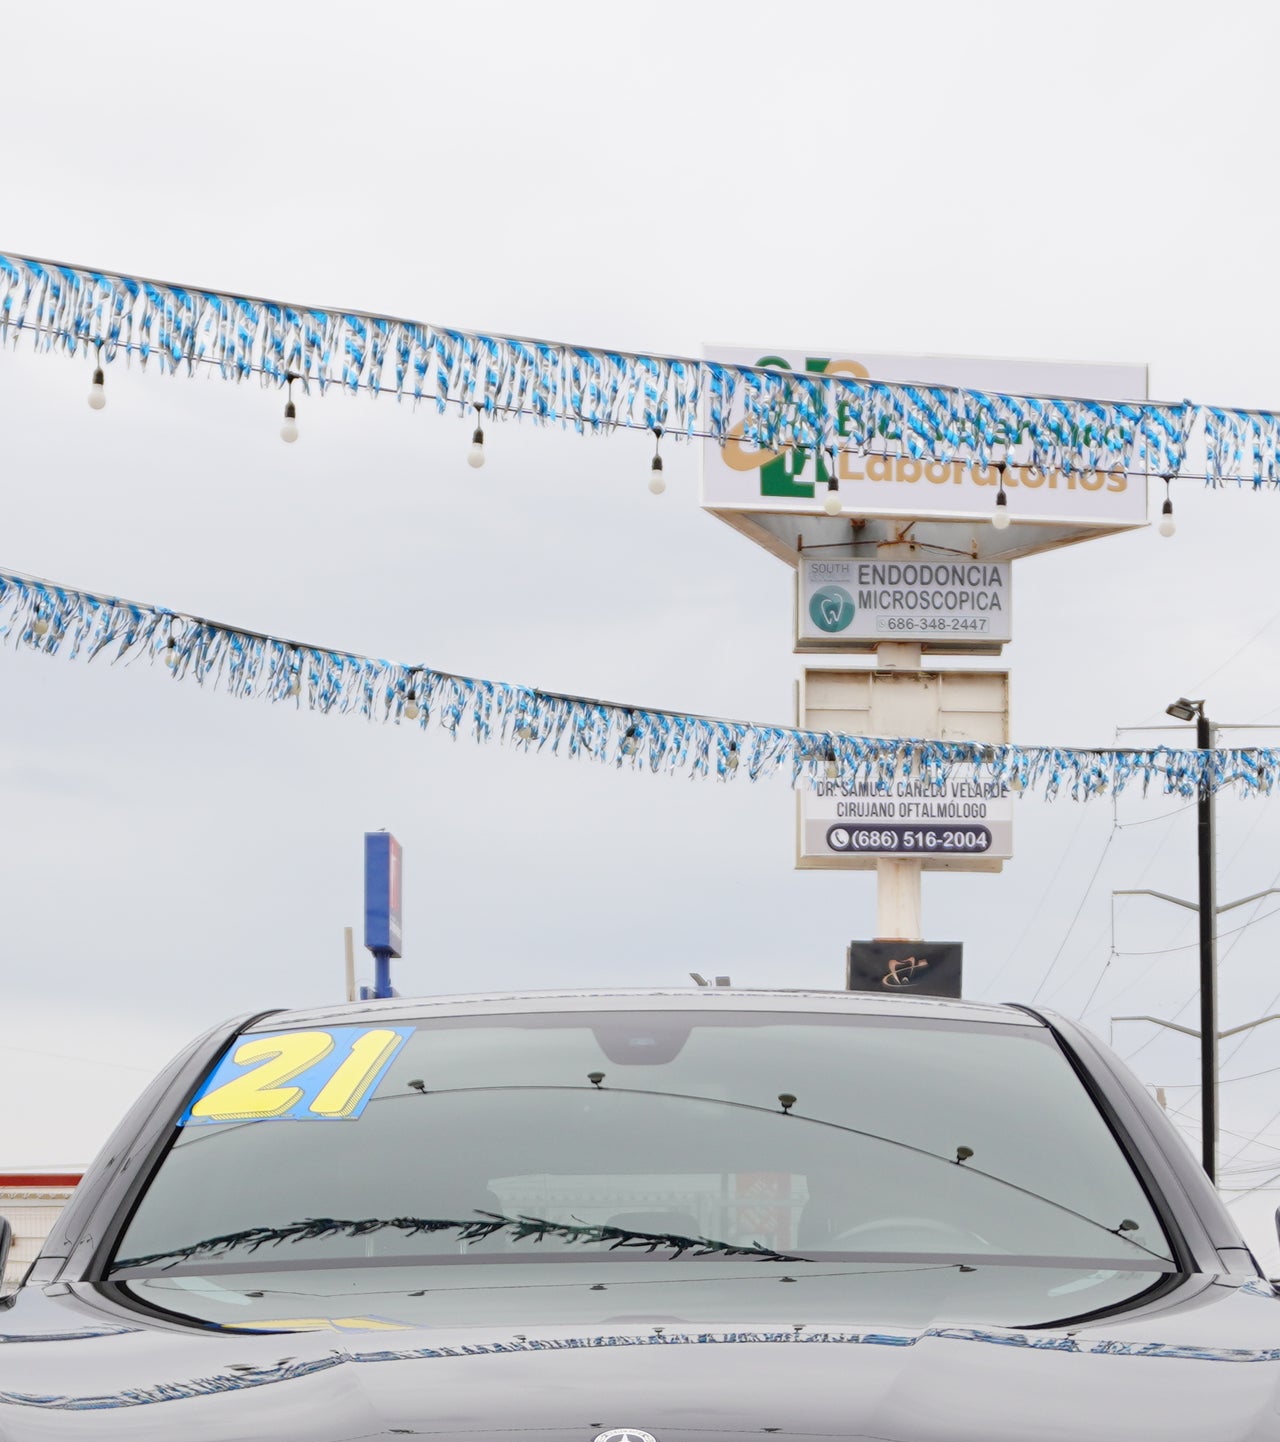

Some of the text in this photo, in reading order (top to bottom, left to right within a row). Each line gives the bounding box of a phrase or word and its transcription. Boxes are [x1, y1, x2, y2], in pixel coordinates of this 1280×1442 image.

[810, 562, 849, 574] SOUTH
[858, 564, 1002, 587] ENDODONCIA
[858, 590, 1002, 611] MICROSCOPICA
[888, 618, 987, 630] 686-348-2447
[837, 800, 987, 818] CIRUJANO OFTALMÓLOGO
[851, 830, 988, 848] (686) 516-2004
[191, 1029, 403, 1120] 21
